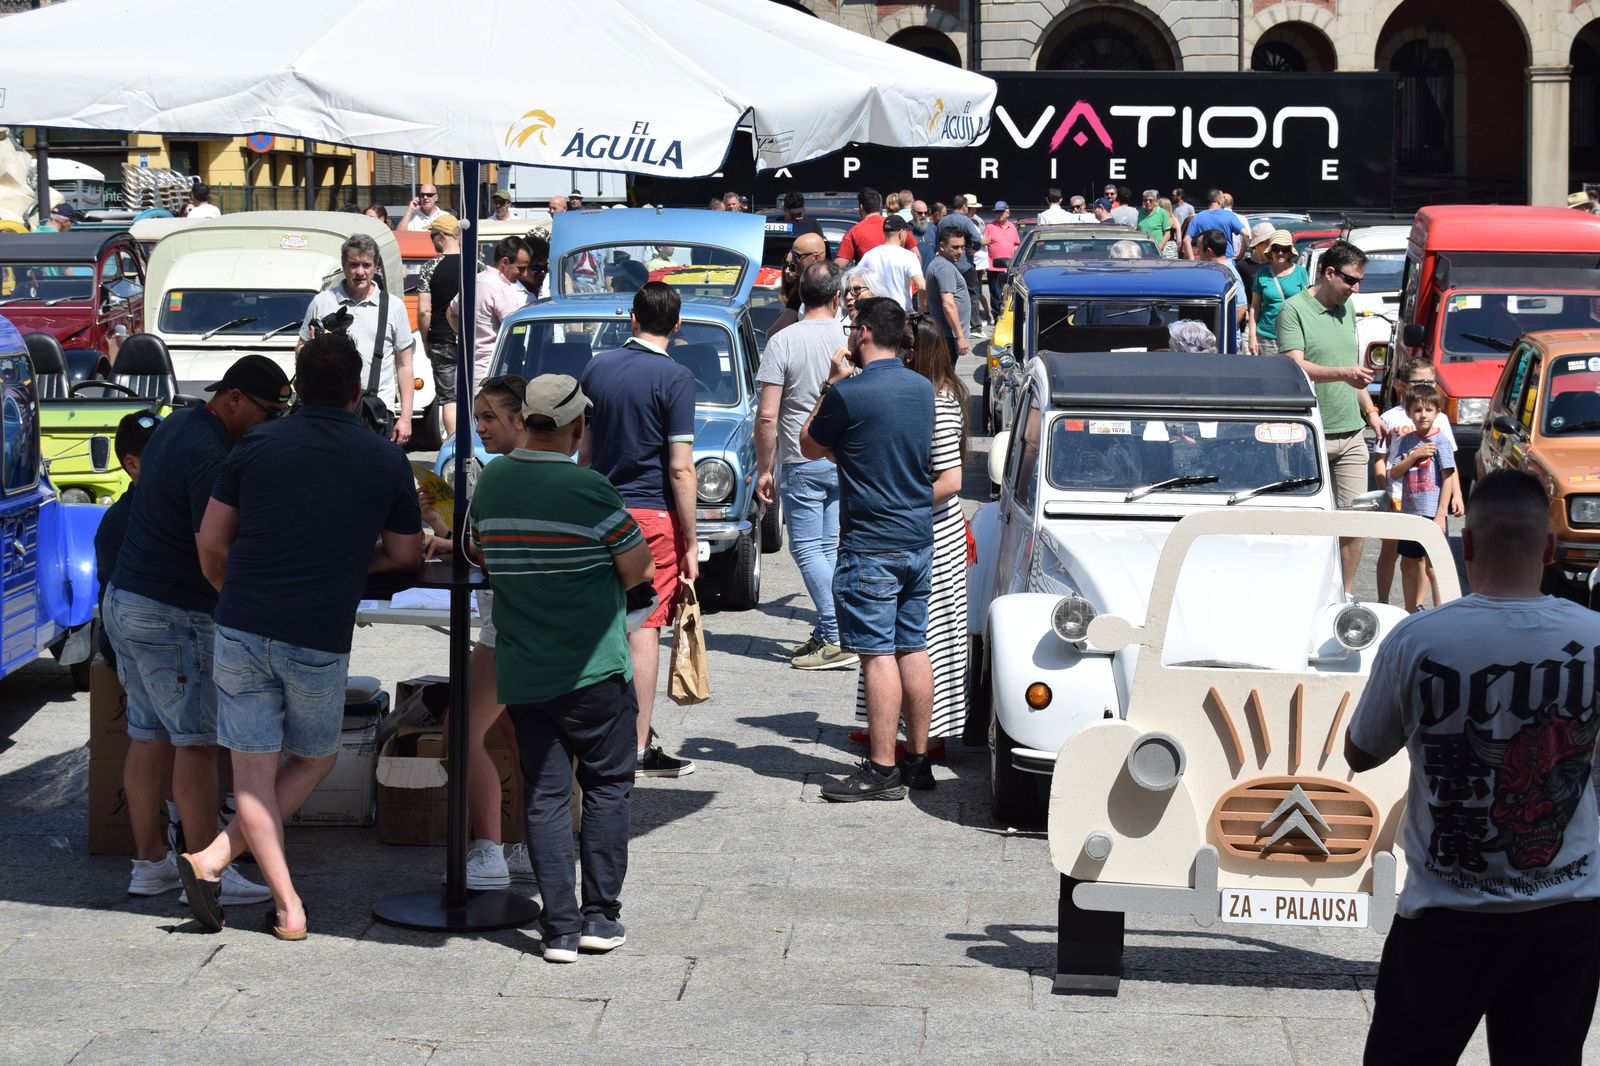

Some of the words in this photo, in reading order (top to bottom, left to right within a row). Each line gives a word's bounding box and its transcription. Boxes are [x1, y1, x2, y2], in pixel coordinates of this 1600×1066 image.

[631, 121, 650, 136] EL
[561, 128, 684, 170] ÁGUILA
[1229, 894, 1252, 918] ZA
[1276, 896, 1358, 922] PALAUSA
